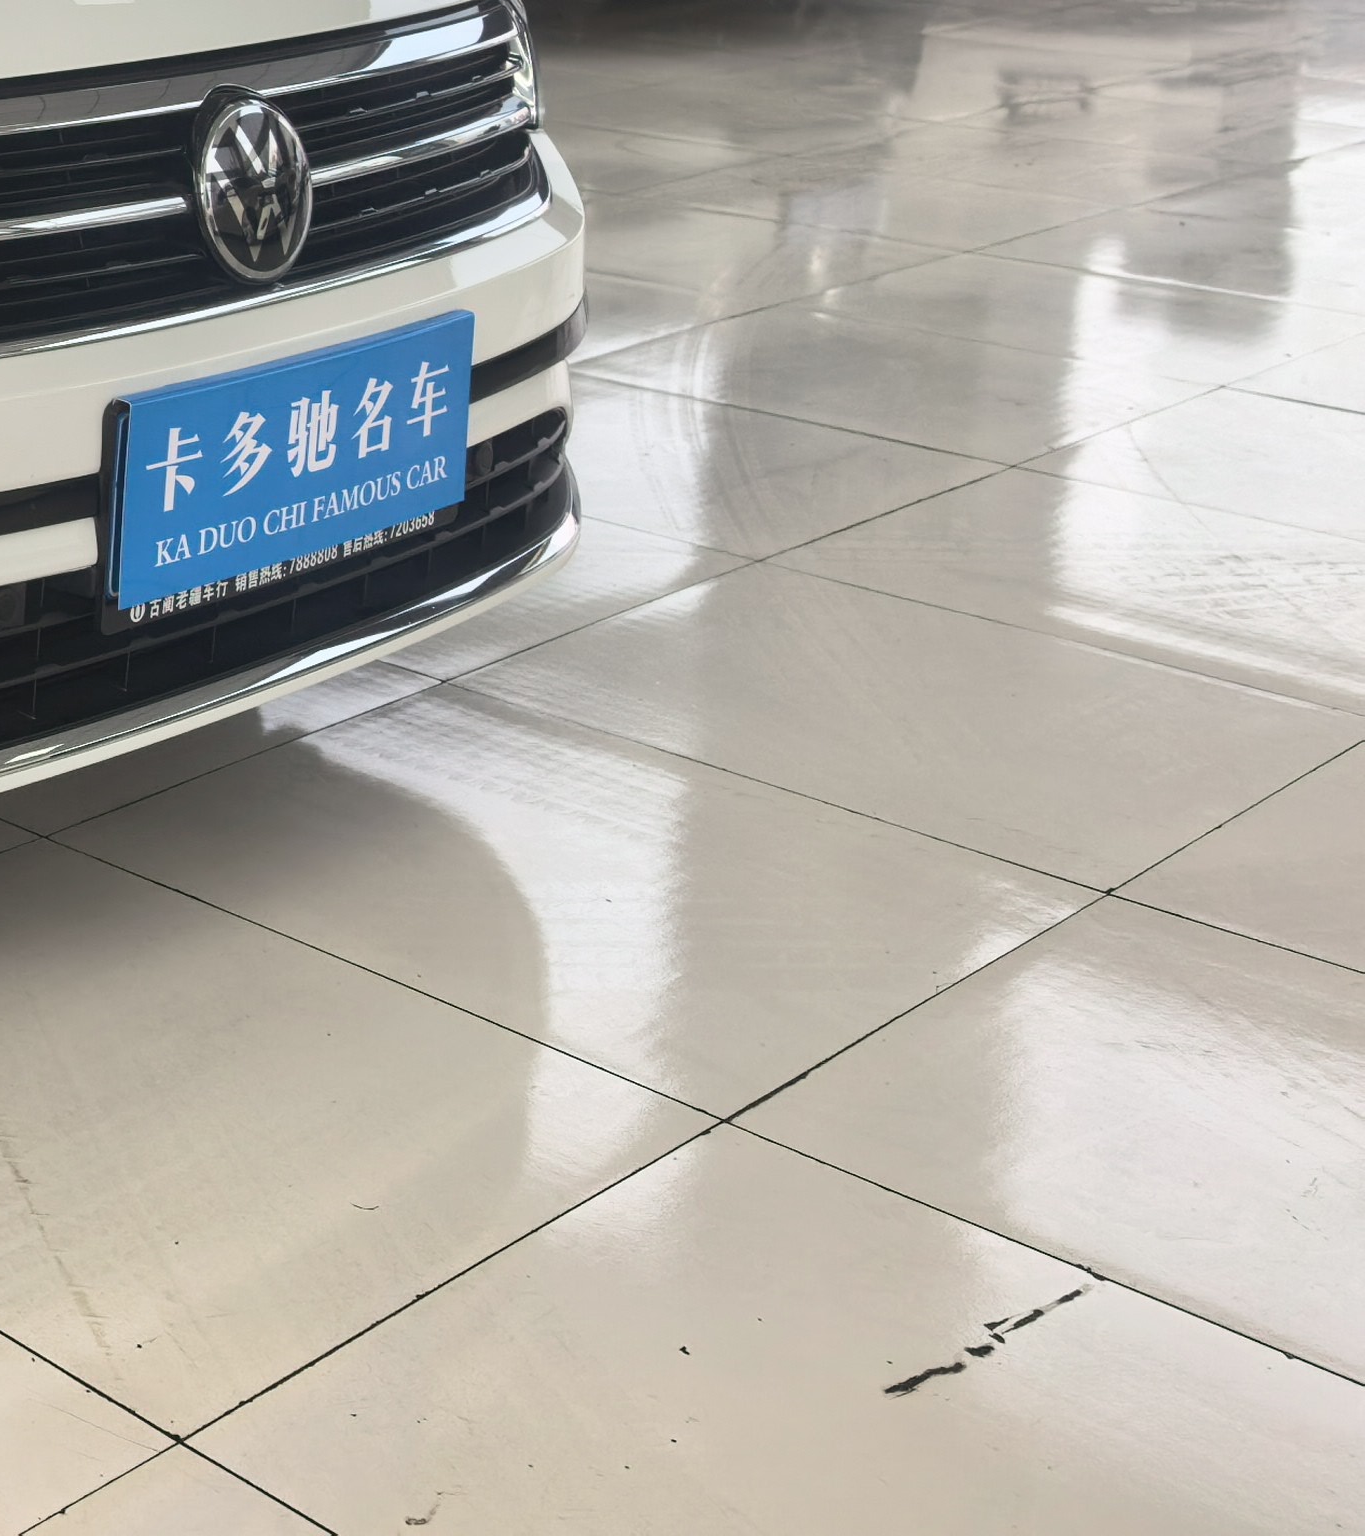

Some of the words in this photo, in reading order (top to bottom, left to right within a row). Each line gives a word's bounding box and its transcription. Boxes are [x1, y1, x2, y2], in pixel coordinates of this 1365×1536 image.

[146, 361, 450, 513] 卡多驰名车
[154, 537, 192, 568] KA
[197, 514, 257, 557] DUO
[263, 500, 307, 537] CHI
[311, 471, 401, 524] FAMOUS
[407, 454, 449, 491] CAR
